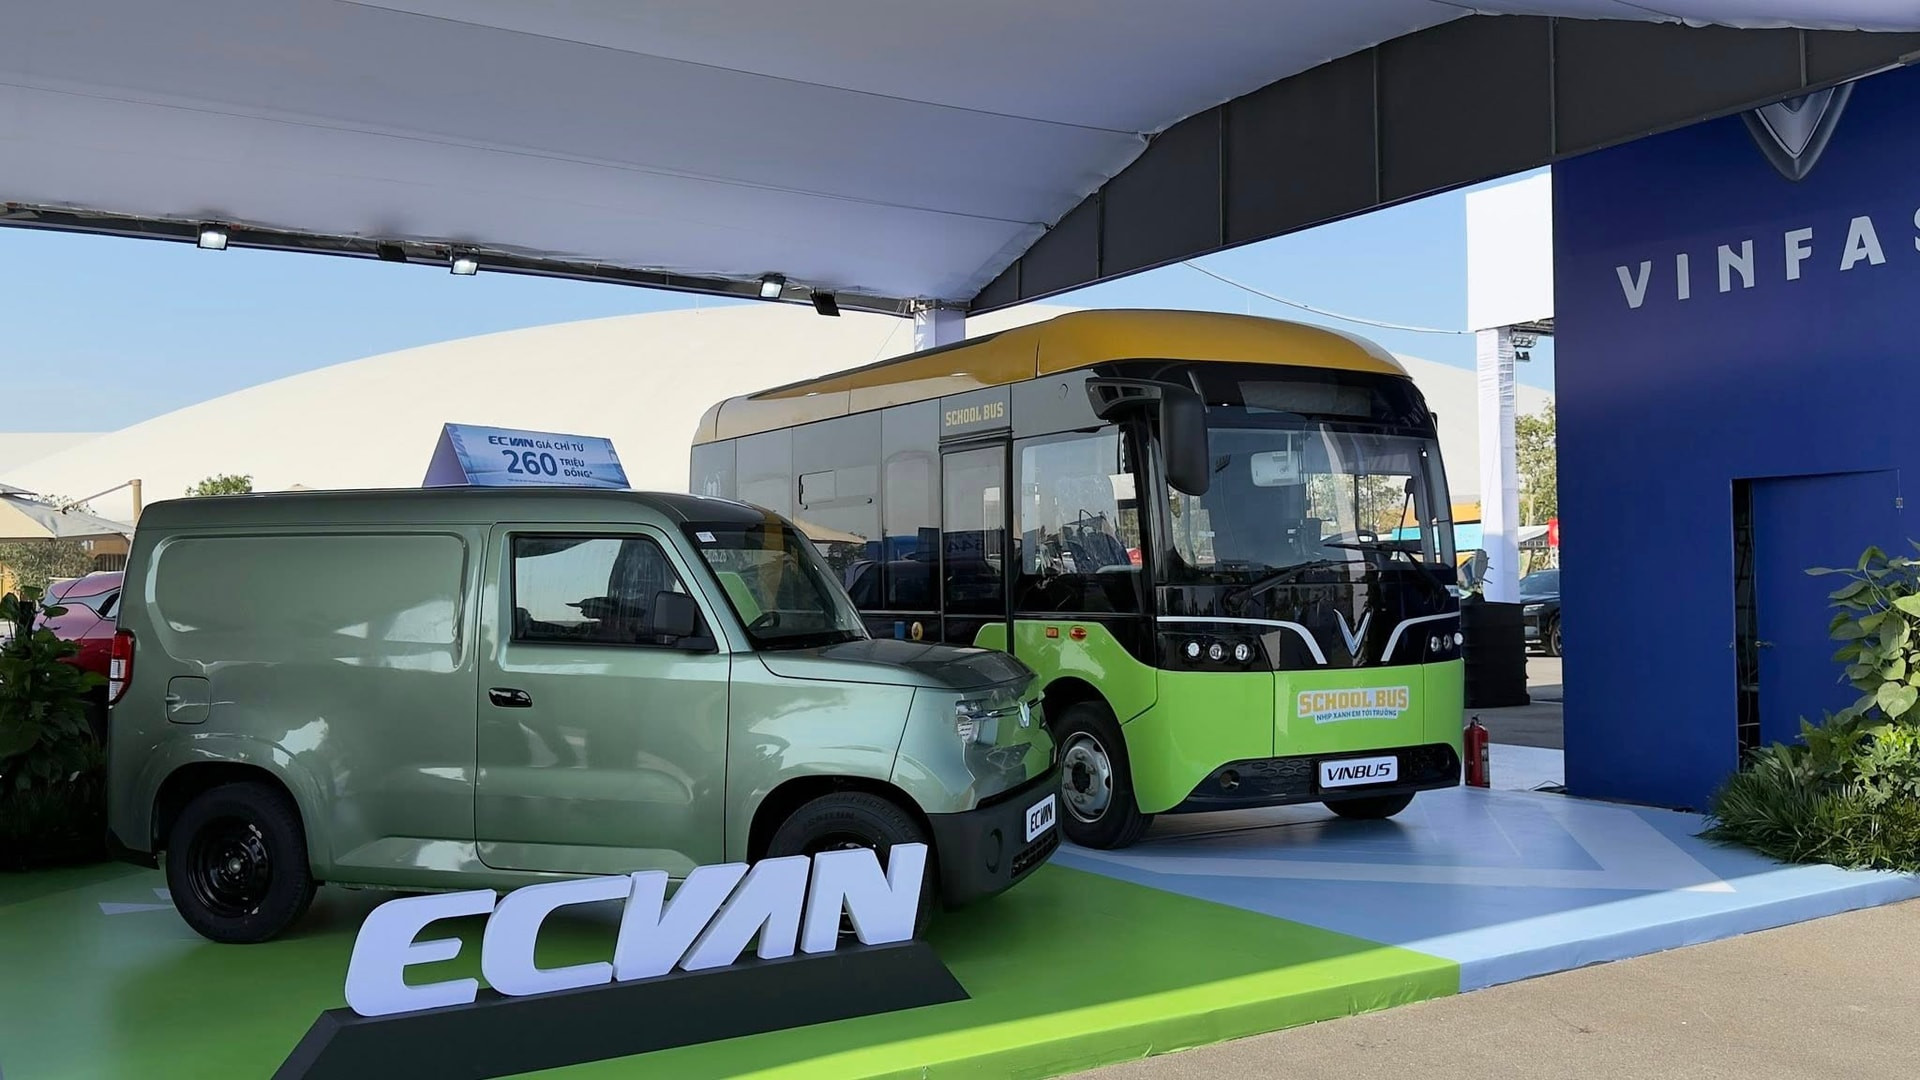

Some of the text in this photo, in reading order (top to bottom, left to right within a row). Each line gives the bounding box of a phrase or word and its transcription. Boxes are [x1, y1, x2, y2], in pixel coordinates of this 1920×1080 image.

[1616, 207, 1920, 309] VINFA
[945, 402, 1004, 427] SCHOOL BUS
[536, 440, 553, 450] GIÁ
[502, 449, 585, 476] 260 TRIỆU
[1299, 688, 1408, 715] SCHOOL BUS
[1333, 710, 1351, 719] XANH
[1352, 709, 1361, 718] EM
[1327, 763, 1391, 781] VINBUS
[1030, 801, 1053, 833] ECVAN
[344, 843, 928, 1017] ECVAN
